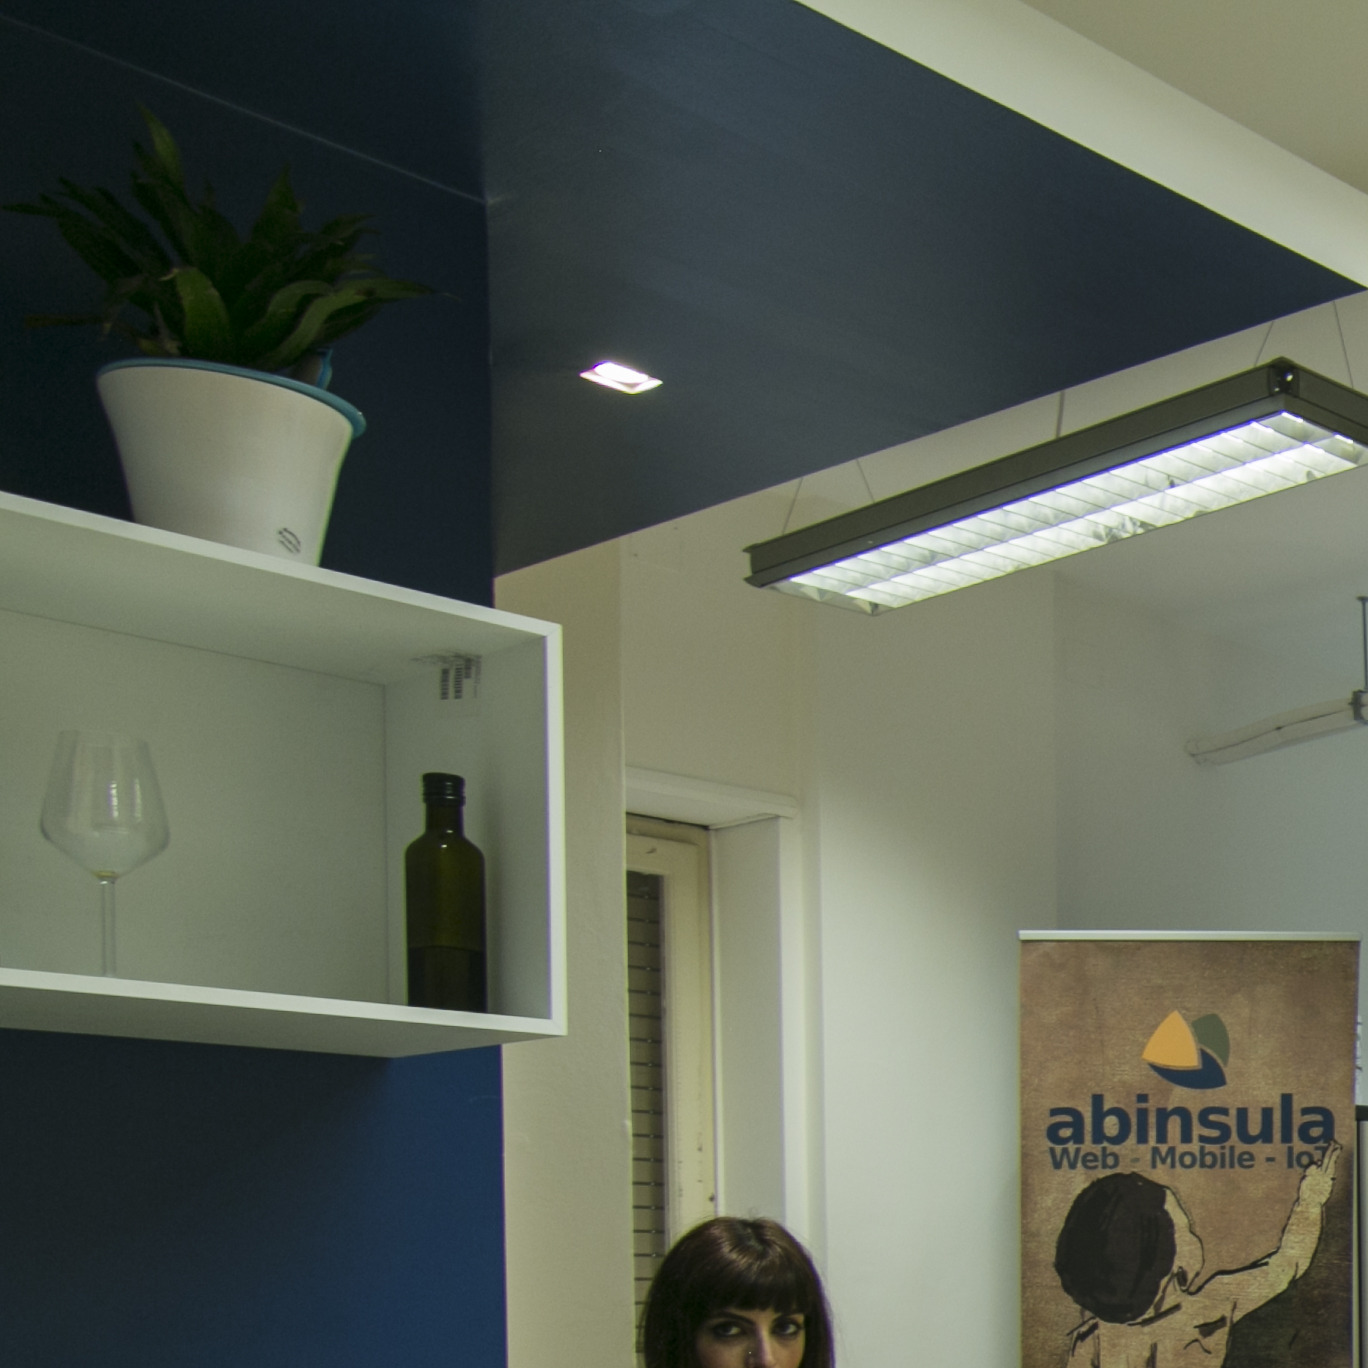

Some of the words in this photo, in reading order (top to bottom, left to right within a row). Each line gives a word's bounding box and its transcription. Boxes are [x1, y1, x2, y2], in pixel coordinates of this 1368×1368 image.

[1046, 1093, 1336, 1146] abinsula
[1049, 1146, 1120, 1170] Web
[1151, 1145, 1256, 1169] Mobile
